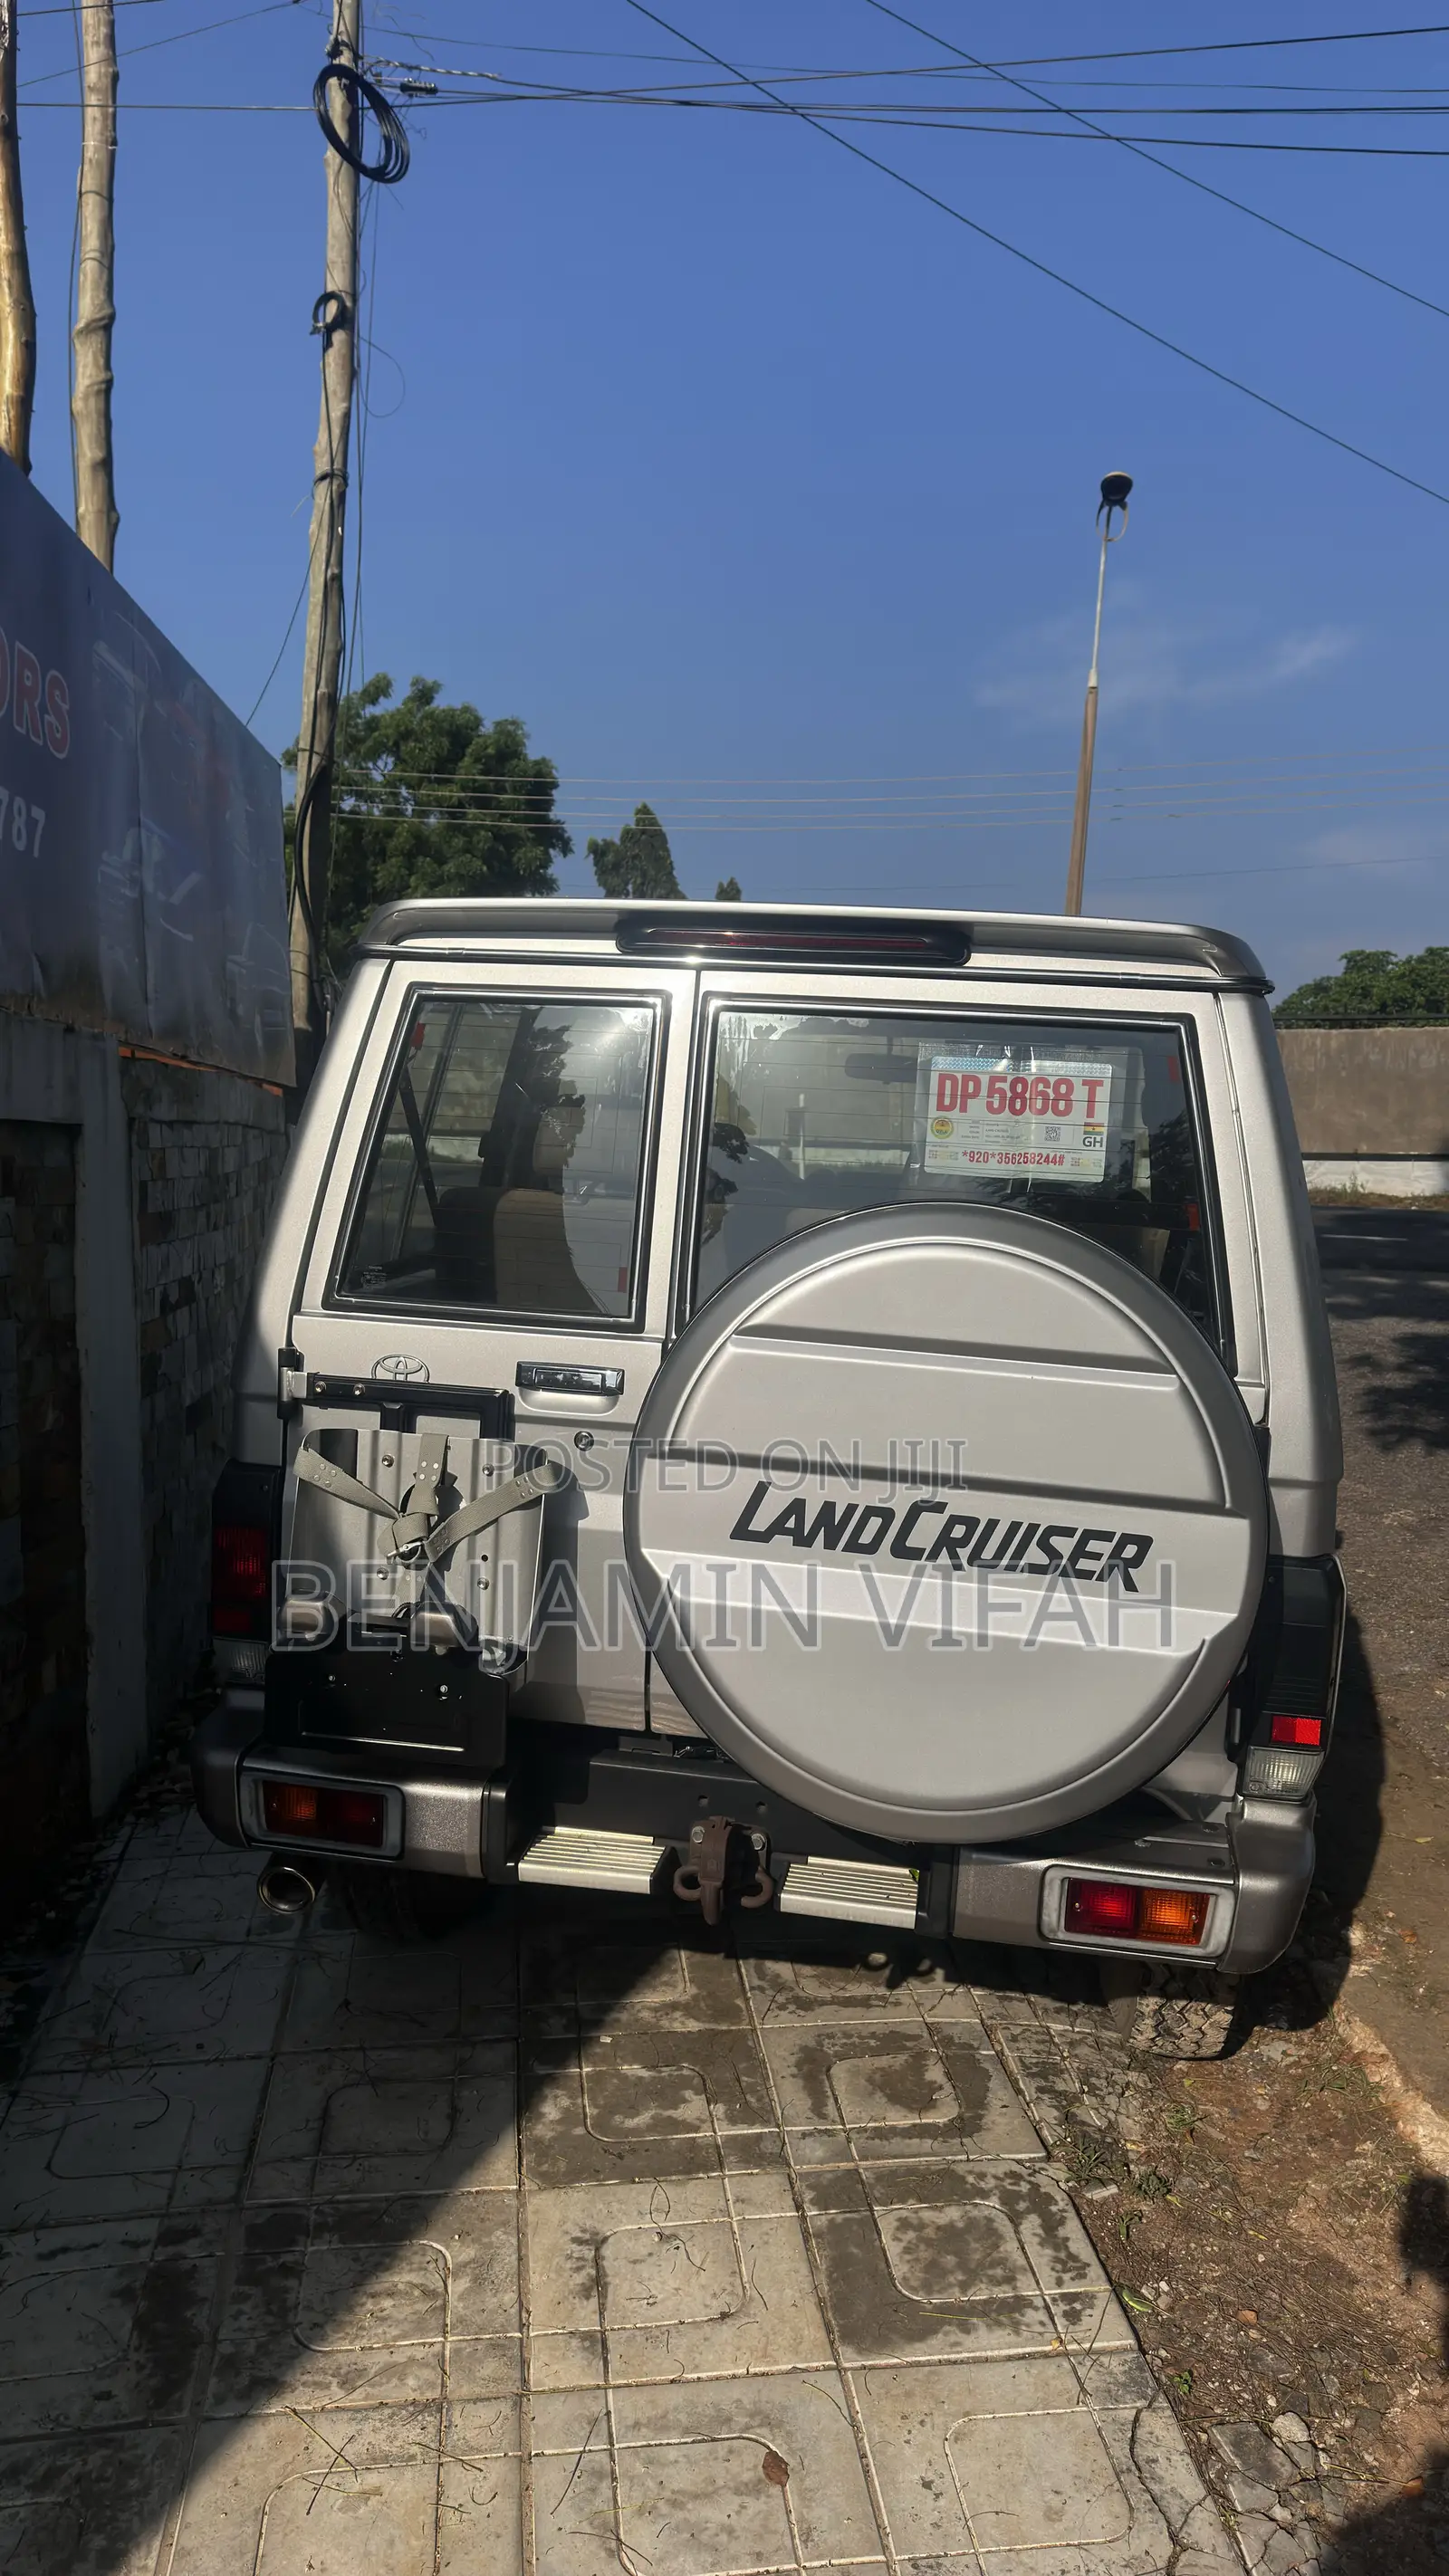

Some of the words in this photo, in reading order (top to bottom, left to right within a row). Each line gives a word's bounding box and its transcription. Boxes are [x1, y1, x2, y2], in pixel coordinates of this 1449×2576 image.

[0, 626, 70, 759] RS
[936, 1073, 982, 1113] DP
[985, 1075, 1074, 1116] 5868
[1081, 1079, 1104, 1118] T
[1082, 1135, 1104, 1148] GH
